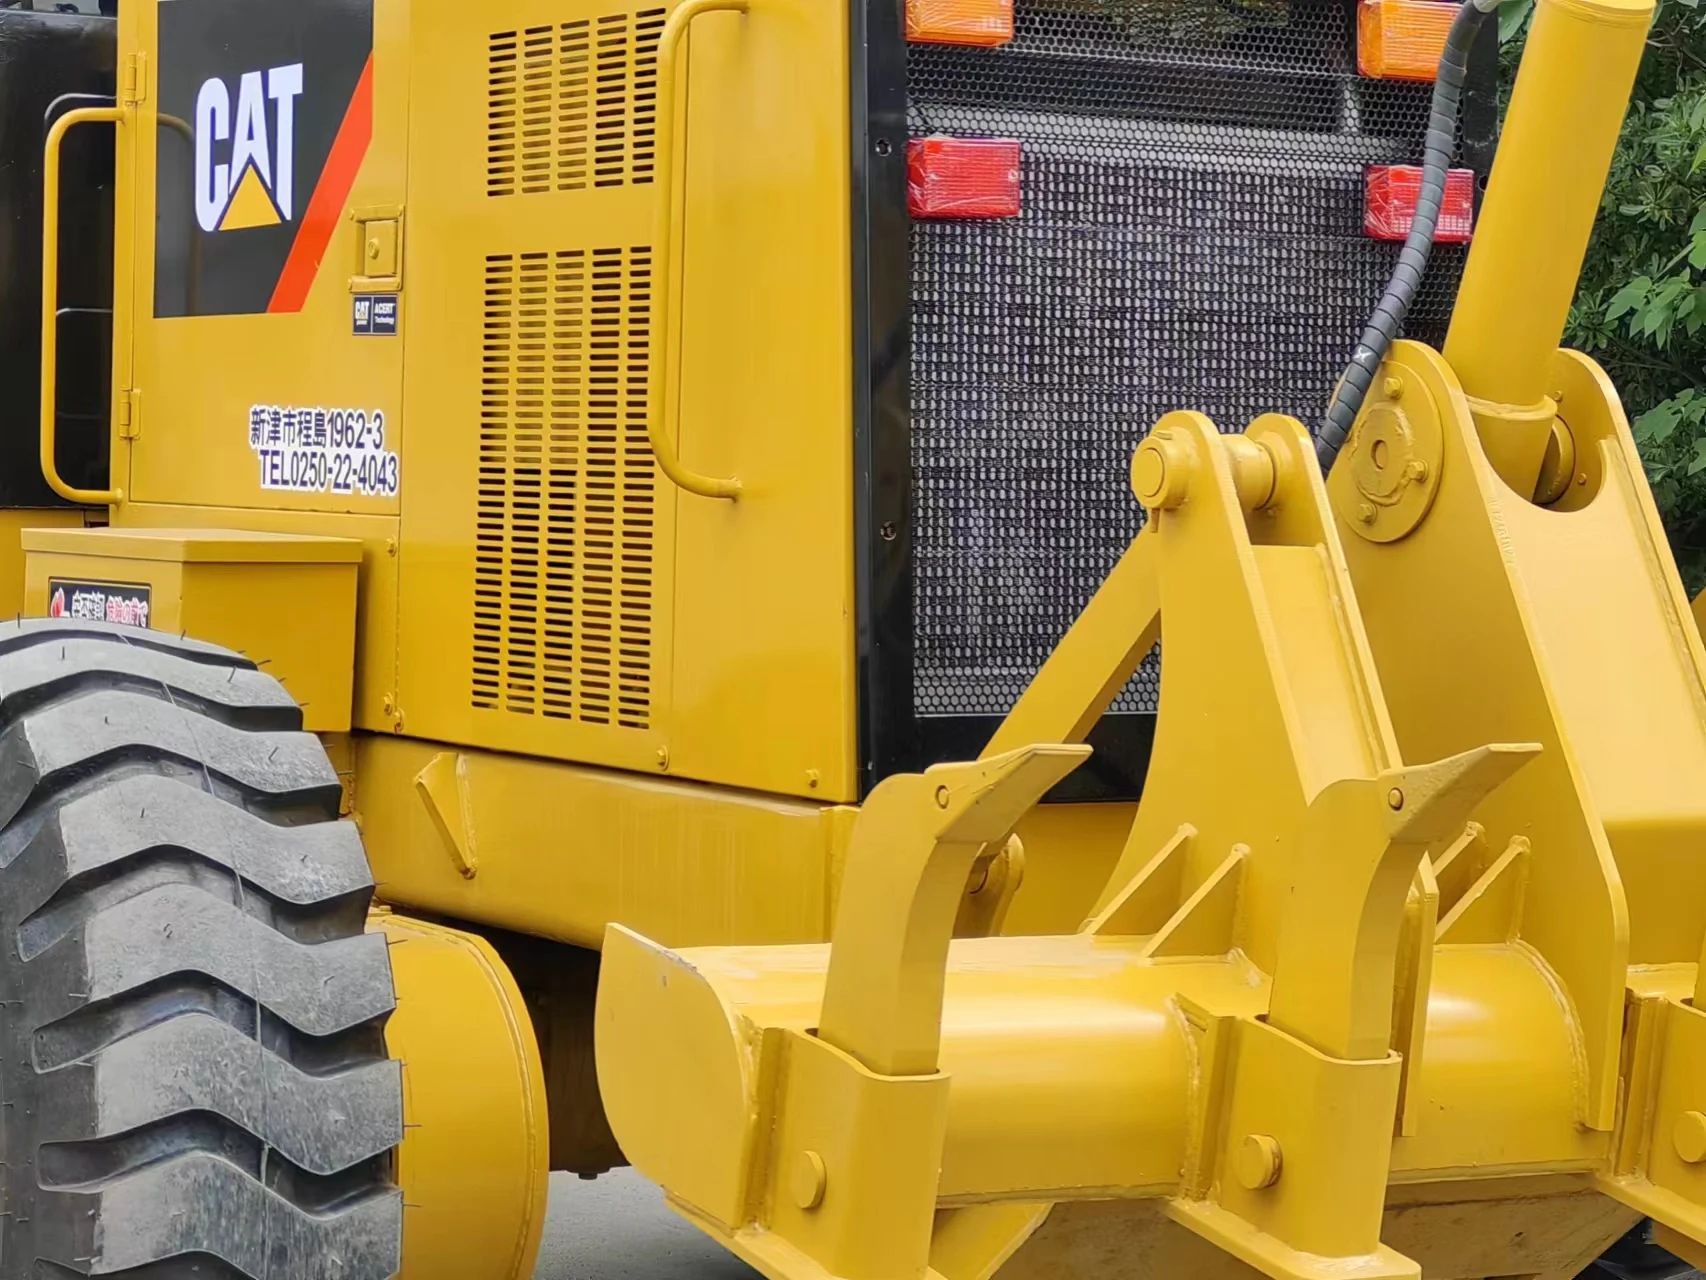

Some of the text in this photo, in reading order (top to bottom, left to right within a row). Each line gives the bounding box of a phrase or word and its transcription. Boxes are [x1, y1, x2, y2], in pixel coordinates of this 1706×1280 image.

[195, 63, 303, 232] CAT
[354, 301, 370, 319] CAT
[250, 407, 384, 450] 新津市程島1962-3
[260, 449, 398, 493] TEL0250-22-4043
